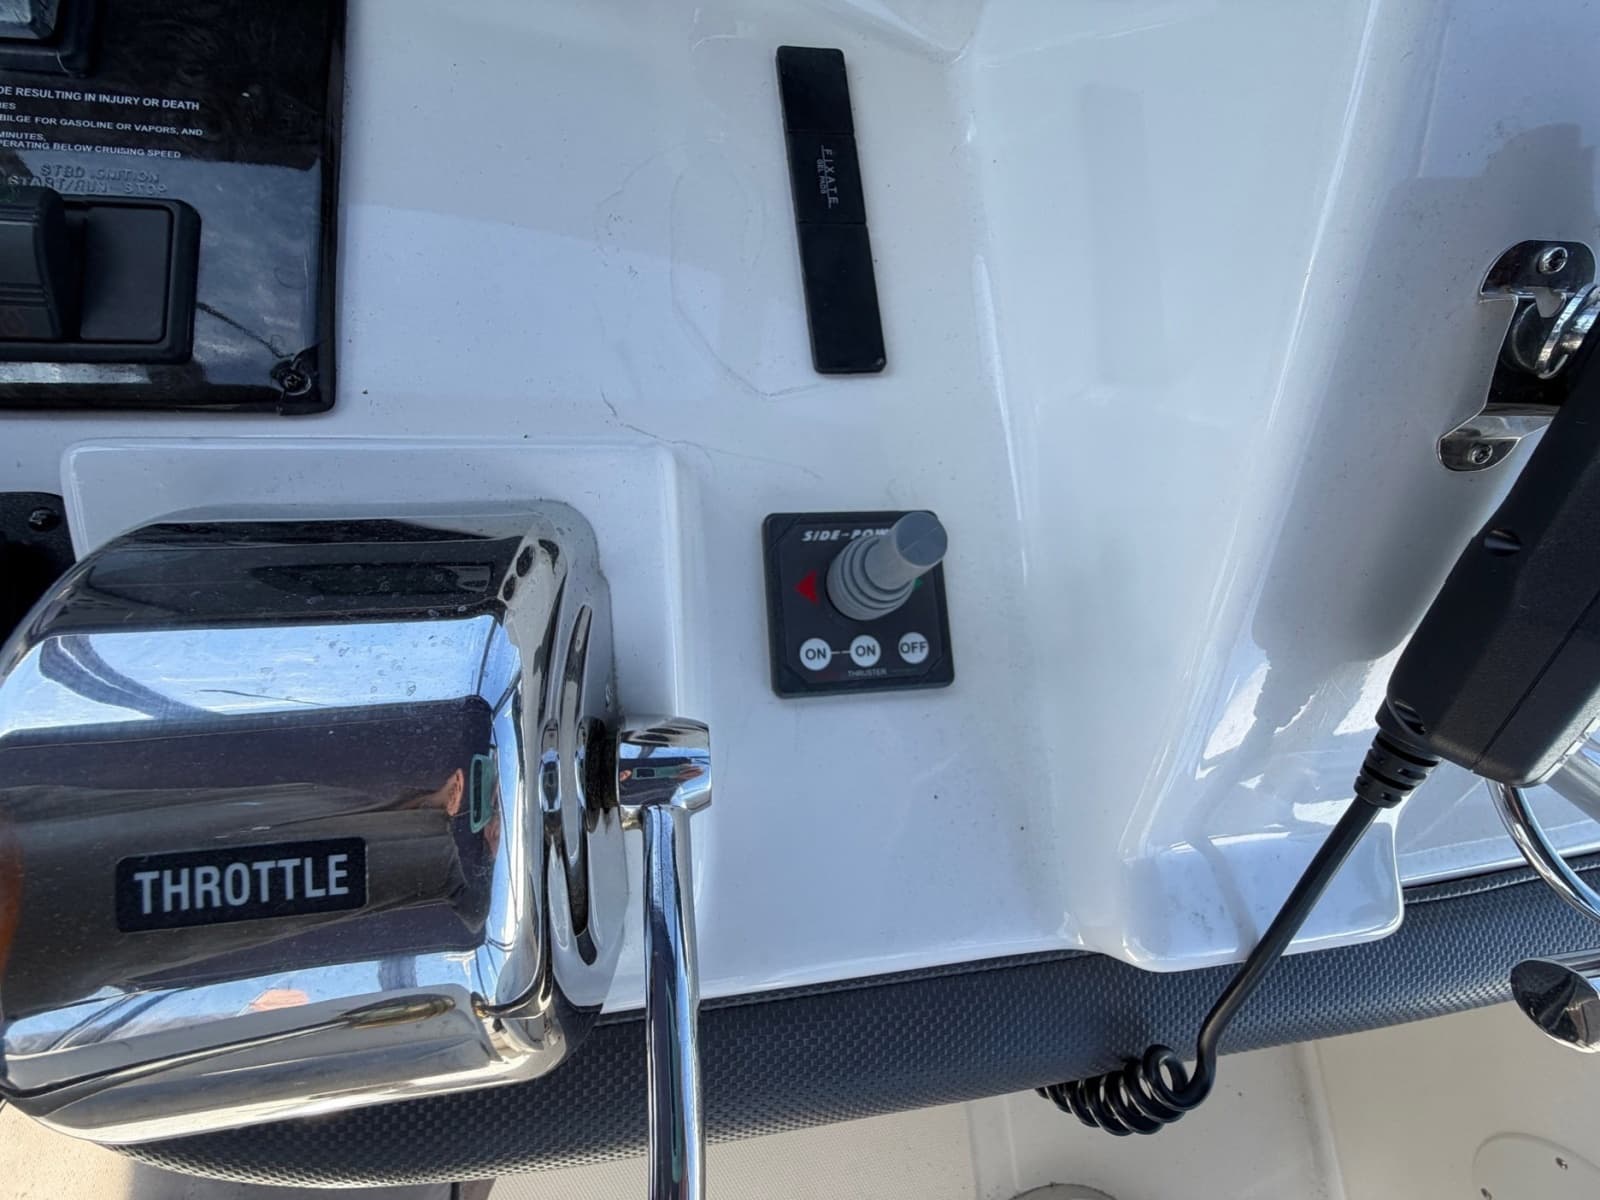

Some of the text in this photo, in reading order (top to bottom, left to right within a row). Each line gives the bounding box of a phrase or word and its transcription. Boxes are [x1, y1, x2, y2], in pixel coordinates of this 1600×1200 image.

[0, 102, 17, 110] ES
[15, 87, 82, 101] RESULTING
[84, 93, 96, 102] IN
[99, 94, 140, 105] INJURY
[142, 97, 159, 107] OR
[162, 99, 200, 111] DEATH
[0, 113, 204, 136] BILGE FOR GASOLINE OR VAPORS, AND
[53, 142, 92, 152] BELOW
[94, 145, 145, 156] CRUISING
[146, 149, 182, 159] SPEED
[40, 163, 86, 178] STBD
[124, 182, 169, 194] STOP
[801, 528, 890, 542] SIDE-POW
[804, 647, 827, 661] ON
[855, 644, 876, 657] ON
[900, 640, 927, 654] OFF
[847, 668, 888, 678] THRUSTER
[133, 853, 349, 915] THROTTLE
